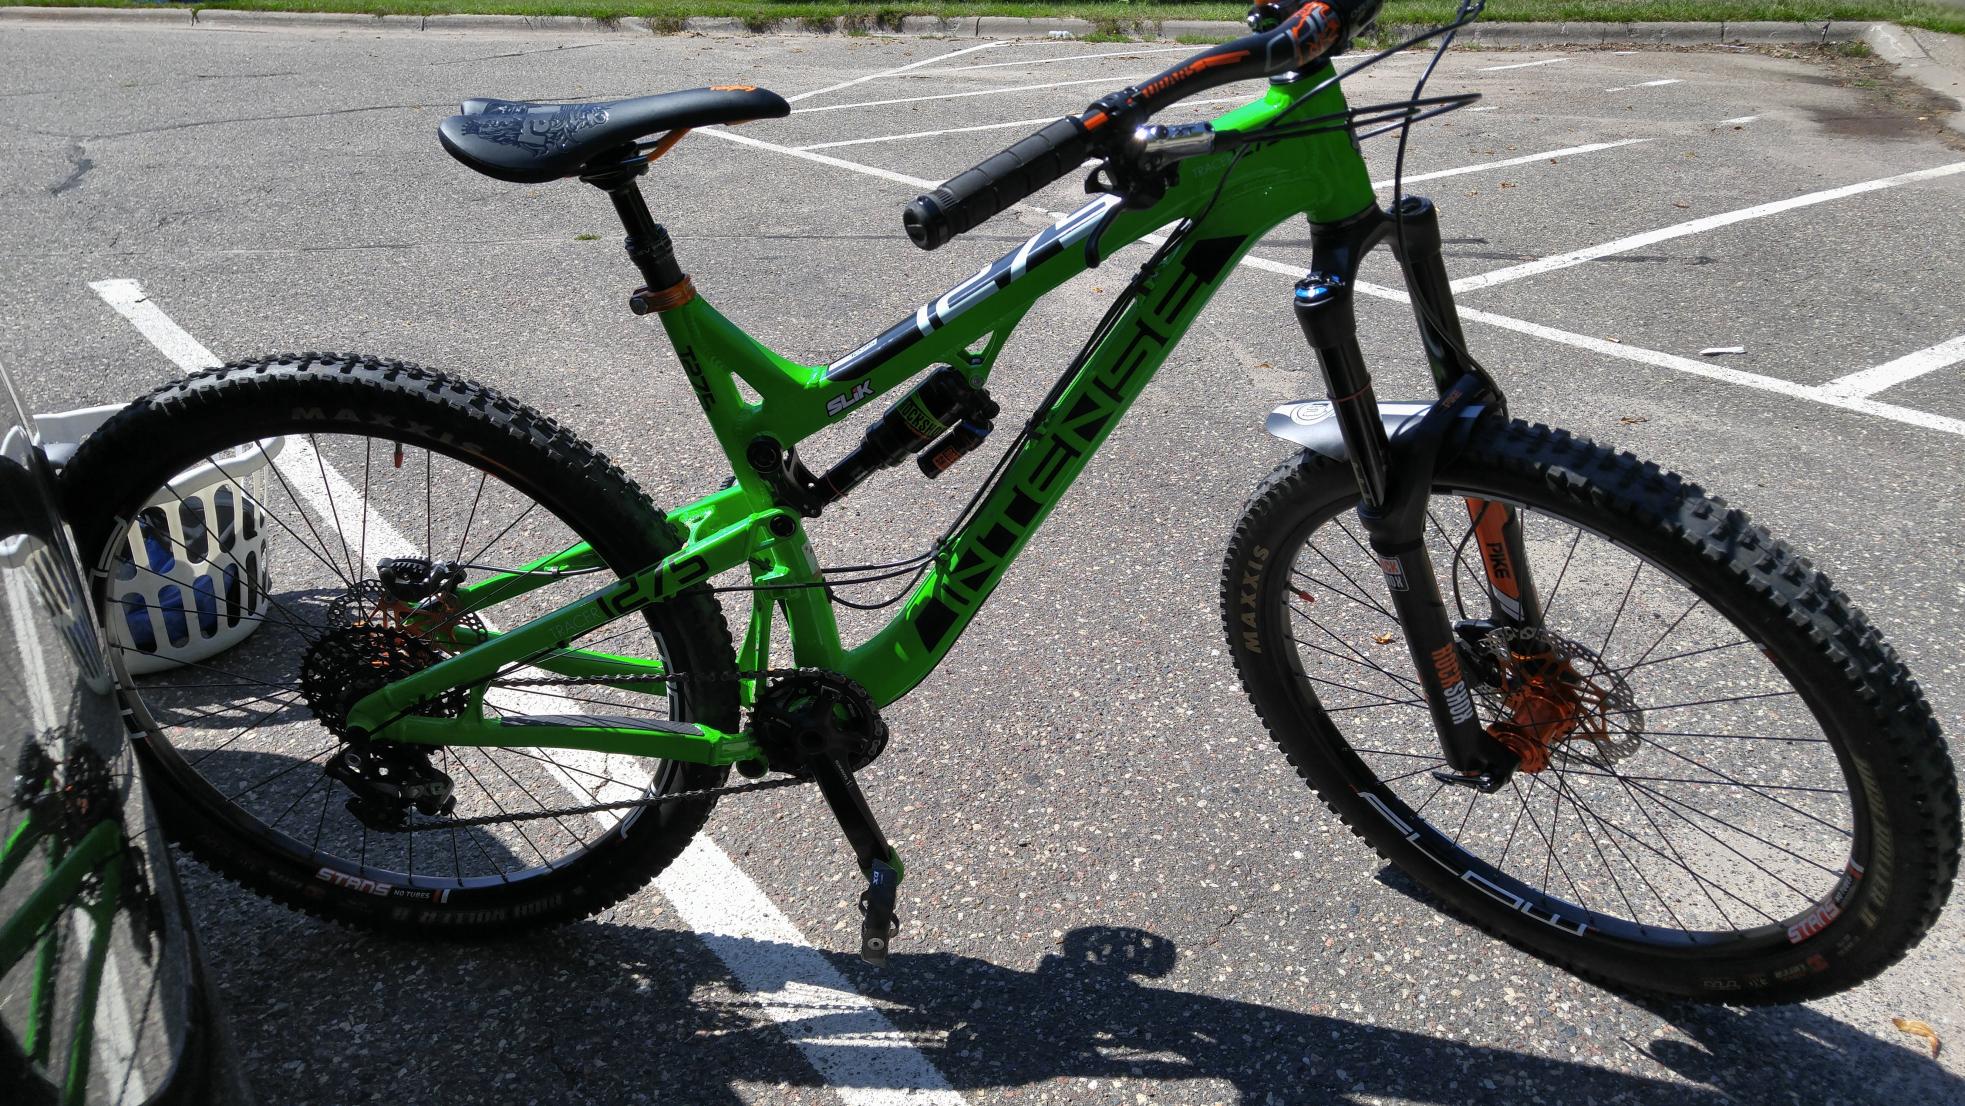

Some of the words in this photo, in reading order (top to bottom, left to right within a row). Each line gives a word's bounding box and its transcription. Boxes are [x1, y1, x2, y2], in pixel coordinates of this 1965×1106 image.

[290, 406, 485, 452] MAXXIS
[930, 256, 1214, 614] INTENSE
[1485, 541, 1512, 581] PIKE
[1240, 544, 1270, 654] MAXXIS
[1432, 642, 1474, 725] ROCKSHOX
[315, 866, 392, 897] STANS
[1787, 902, 1840, 944] STANS
